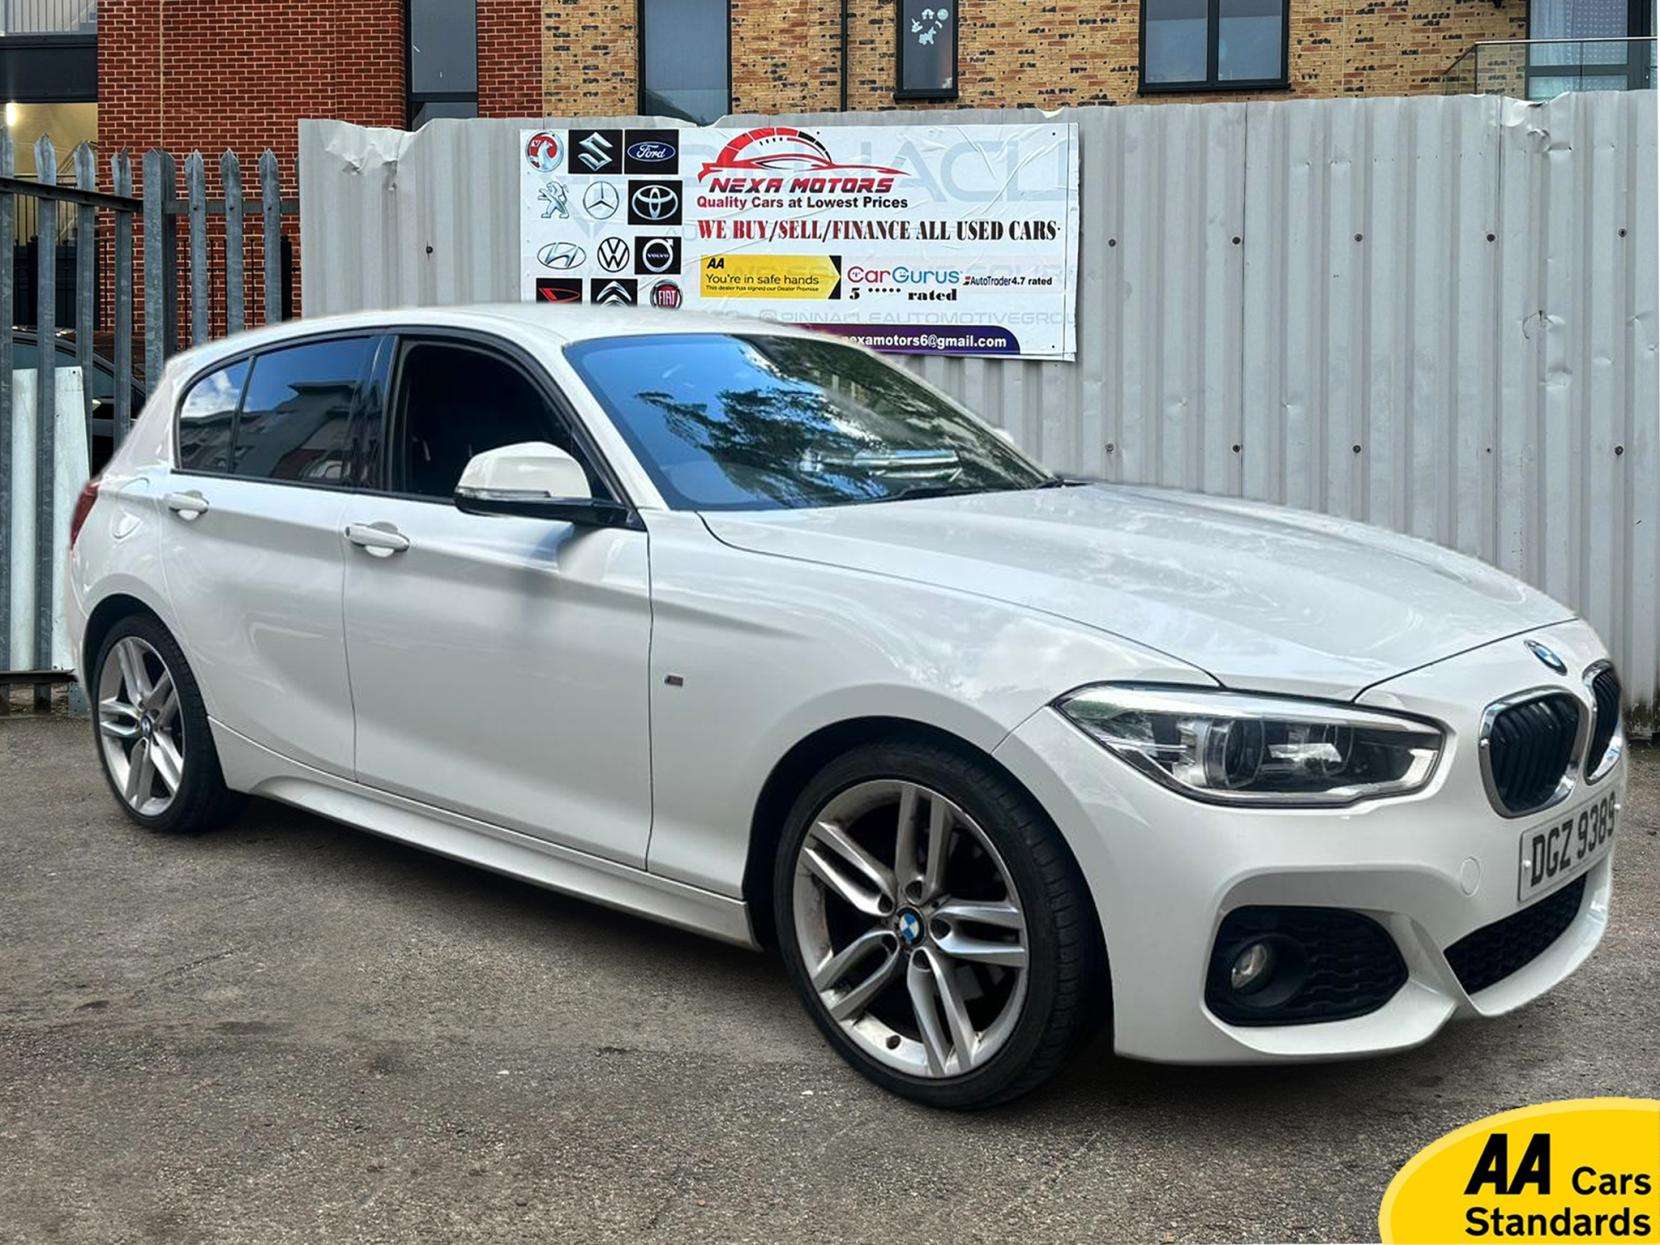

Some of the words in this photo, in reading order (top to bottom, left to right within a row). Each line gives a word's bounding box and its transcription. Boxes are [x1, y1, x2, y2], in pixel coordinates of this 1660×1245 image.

[635, 144, 666, 159] Ford
[709, 177, 784, 194] NEXA
[789, 177, 895, 194] MOTORS
[696, 195, 748, 211] Quality
[751, 196, 784, 208] Cars
[788, 197, 803, 208] at
[807, 196, 859, 209] Lowest
[863, 196, 909, 209] Prices
[697, 219, 727, 240] WE
[733, 219, 911, 243] BUY/SELL/FINANCE
[916, 220, 951, 241] ALL
[957, 220, 1004, 241] USED
[1009, 220, 1057, 241] CARS
[706, 257, 725, 269] AA
[705, 273, 741, 285] You're
[744, 273, 754, 284] in
[757, 273, 781, 285] safe
[783, 274, 820, 285] hands
[847, 265, 961, 285] CarGurus
[1028, 276, 1053, 286] rated
[657, 289, 677, 306] FIAT
[849, 287, 861, 301] 5
[908, 288, 957, 301] rated
[1530, 819, 1573, 887] DGZ
[1577, 791, 1616, 859] 9389
